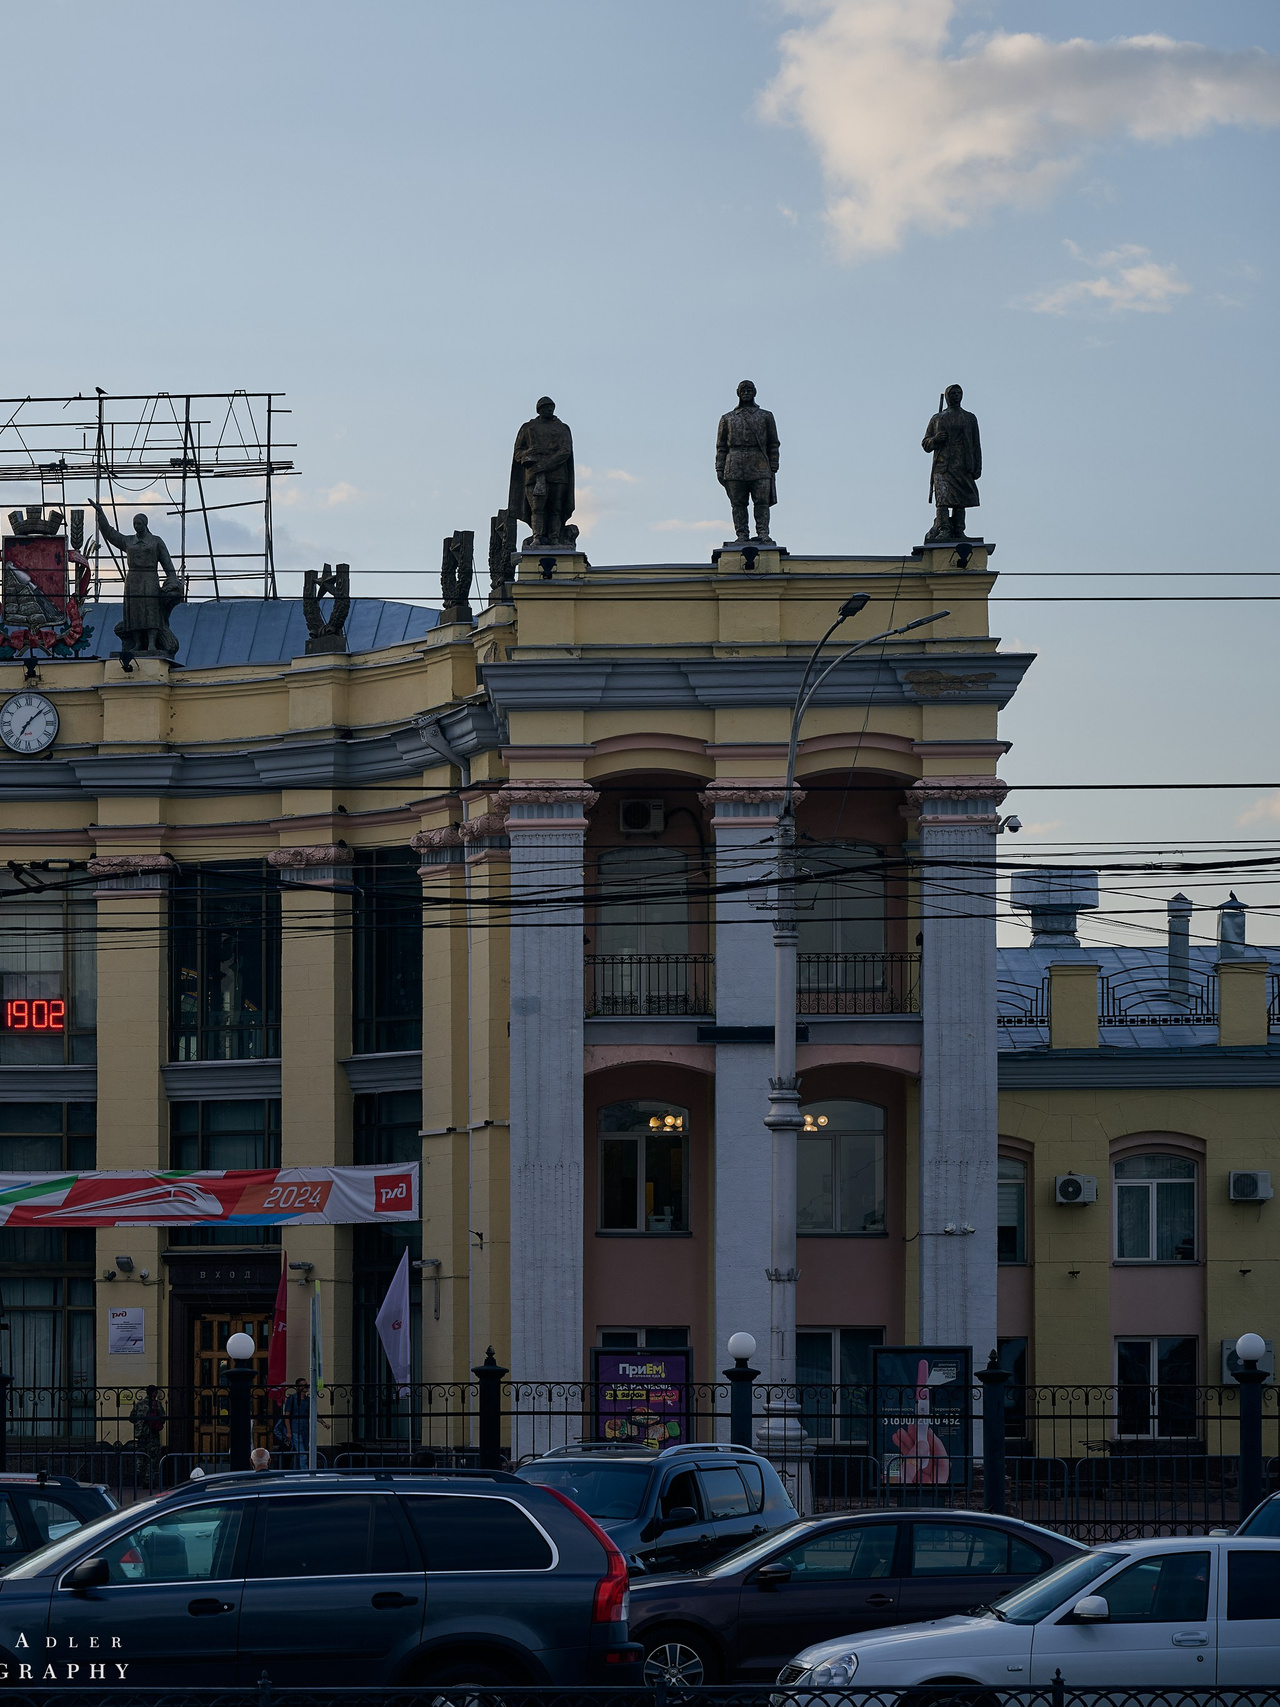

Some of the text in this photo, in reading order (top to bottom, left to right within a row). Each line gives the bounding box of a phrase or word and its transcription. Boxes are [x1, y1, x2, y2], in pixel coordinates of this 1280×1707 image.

[6, 1000, 65, 1029] 1902
[263, 1186, 322, 1208] 2024
[200, 1271, 251, 1279] ВХОД
[619, 1361, 666, 1379] ПриЕм!
